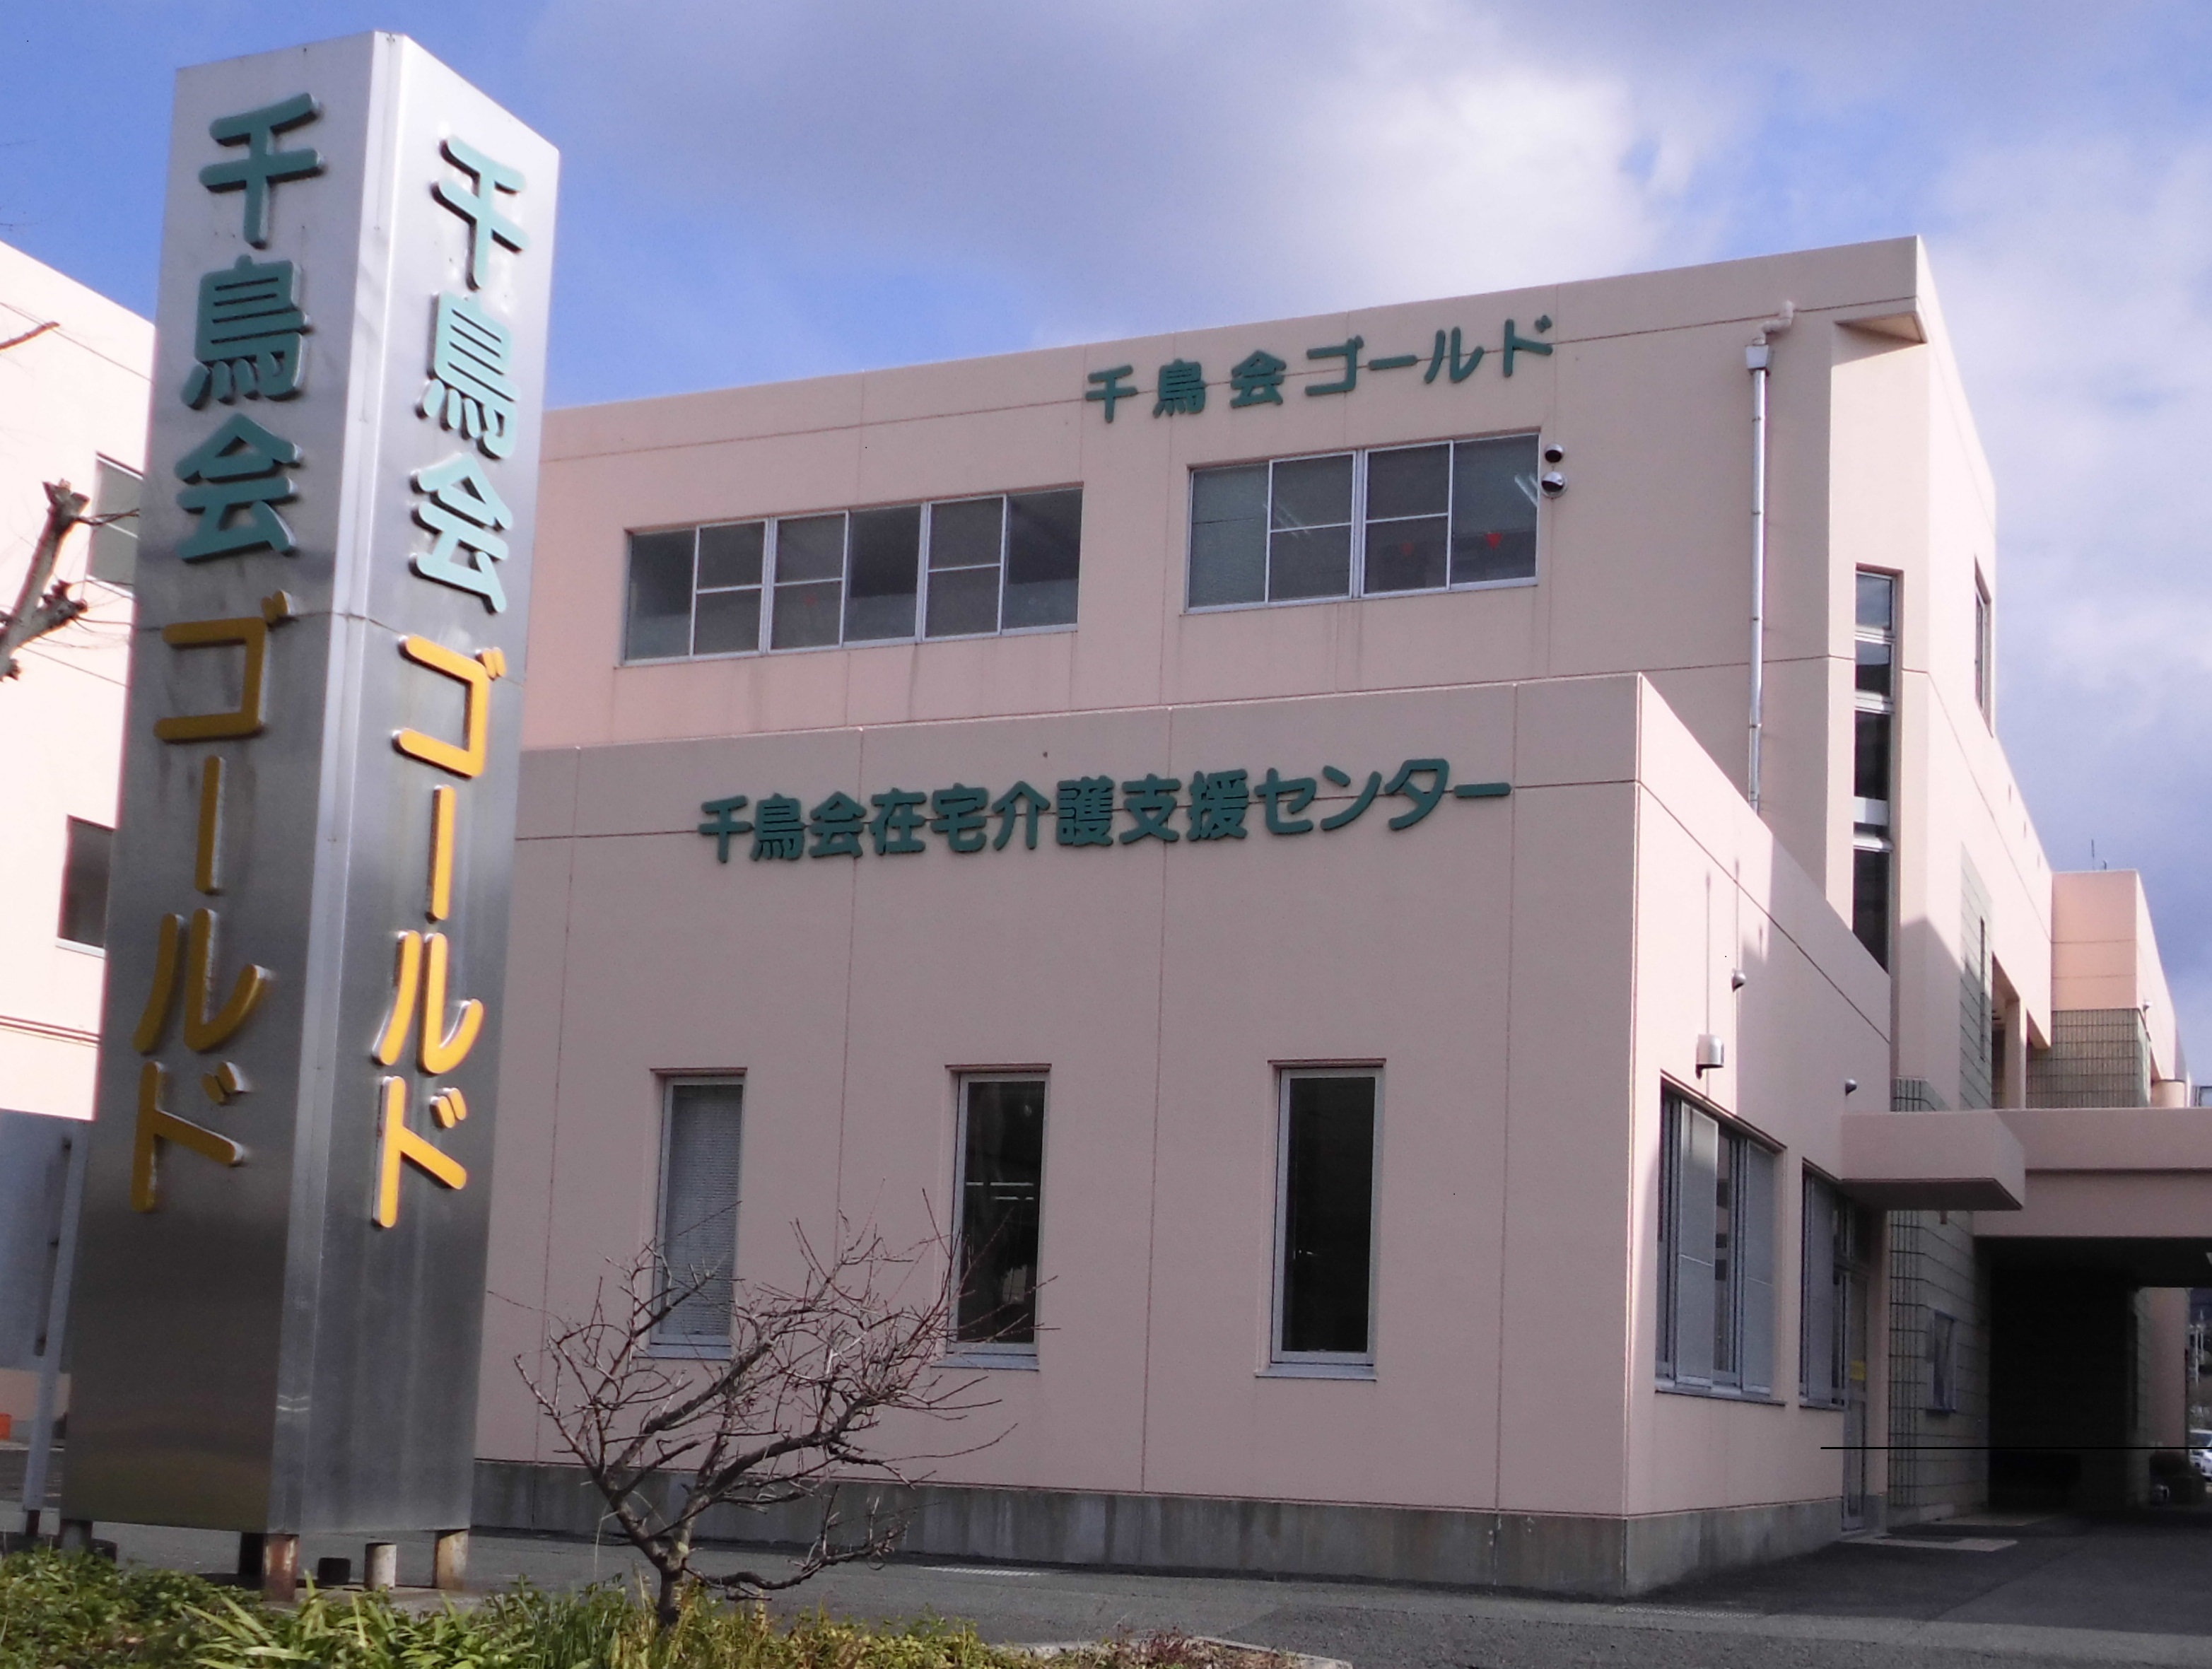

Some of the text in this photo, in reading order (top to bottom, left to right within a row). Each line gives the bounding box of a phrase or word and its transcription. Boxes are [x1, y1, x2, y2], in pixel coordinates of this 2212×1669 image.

[131, 92, 325, 1212] 千鳥会ゴールド
[1085, 315, 1553, 423] 千鳥会ゴールド
[373, 136, 530, 1229] 千鳥会ゴールド
[699, 758, 1511, 864] 千鳥会在宅介護支援センター
